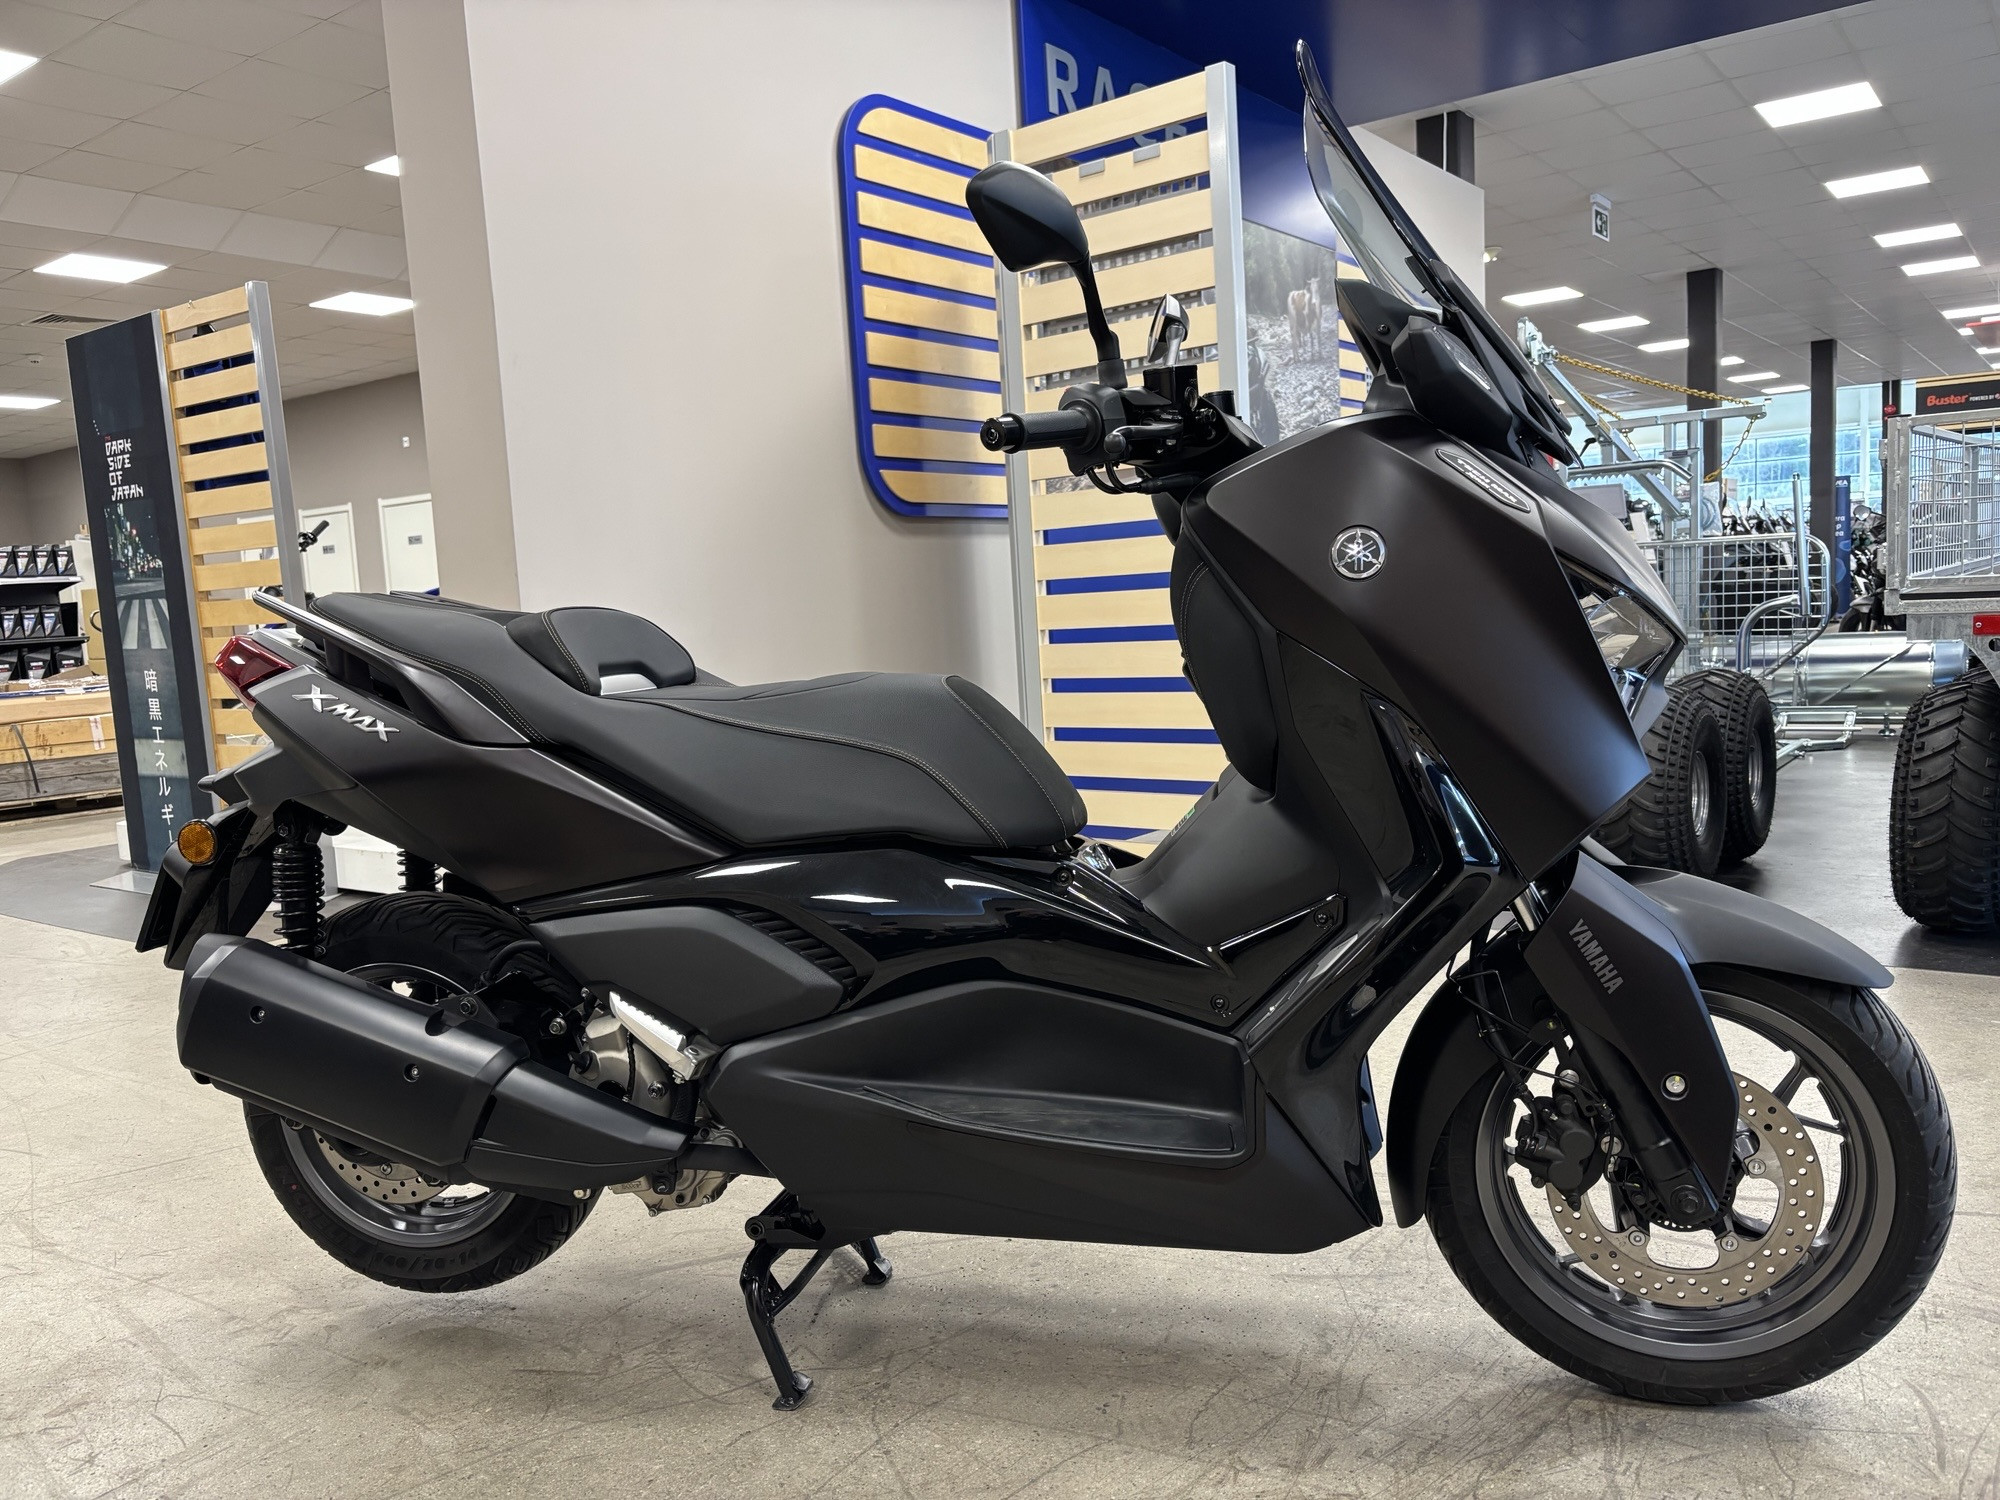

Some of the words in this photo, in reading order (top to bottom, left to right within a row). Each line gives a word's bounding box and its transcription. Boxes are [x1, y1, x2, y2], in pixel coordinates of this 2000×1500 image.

[1926, 394, 1969, 407] Buster
[105, 438, 132, 456] DARK
[108, 471, 123, 486] OF
[111, 484, 144, 501] JAPAN
[144, 669, 174, 842] 暗黒エネルギー
[1569, 918, 1623, 994] YAMAHA
